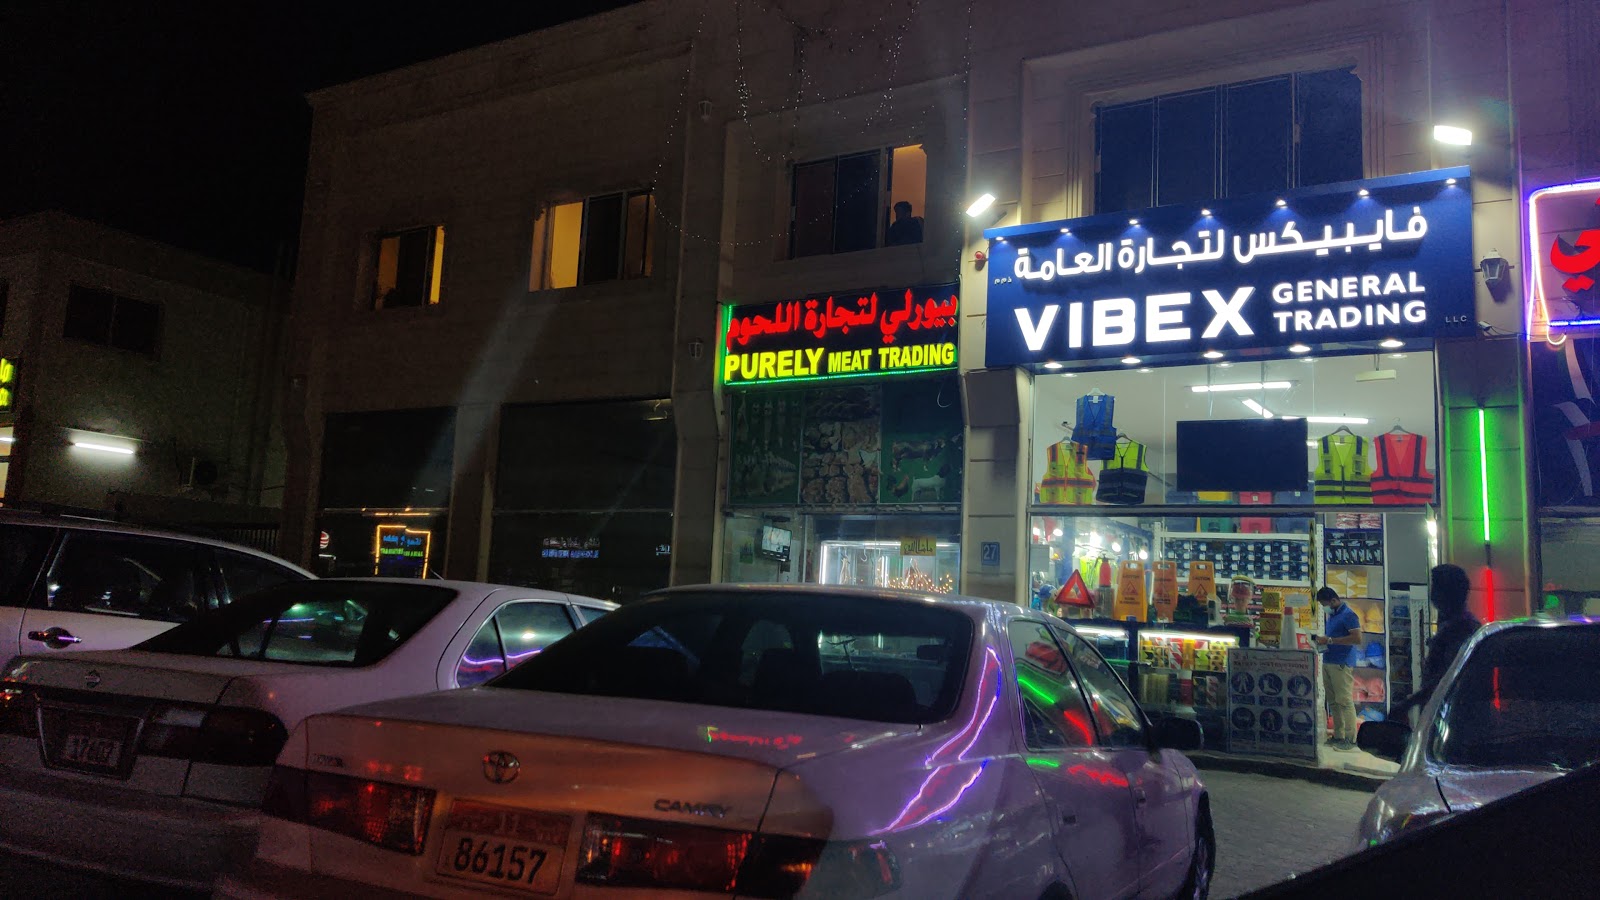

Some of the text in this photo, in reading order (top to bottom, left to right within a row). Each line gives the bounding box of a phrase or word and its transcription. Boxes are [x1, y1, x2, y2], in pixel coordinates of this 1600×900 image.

[1014, 206, 1429, 281] فايبيكس لتجارة العامة
[1271, 272, 1426, 305] GENERAL
[725, 288, 959, 352] بيورلي لتجارة اللحوم
[1014, 287, 1255, 352] VIBEX
[1273, 299, 1427, 334] TRADING
[725, 342, 955, 382] PURELY MEAT TRADING
[983, 543, 997, 560] 27
[654, 799, 732, 820] CAMRY
[453, 837, 548, 884] 86157
